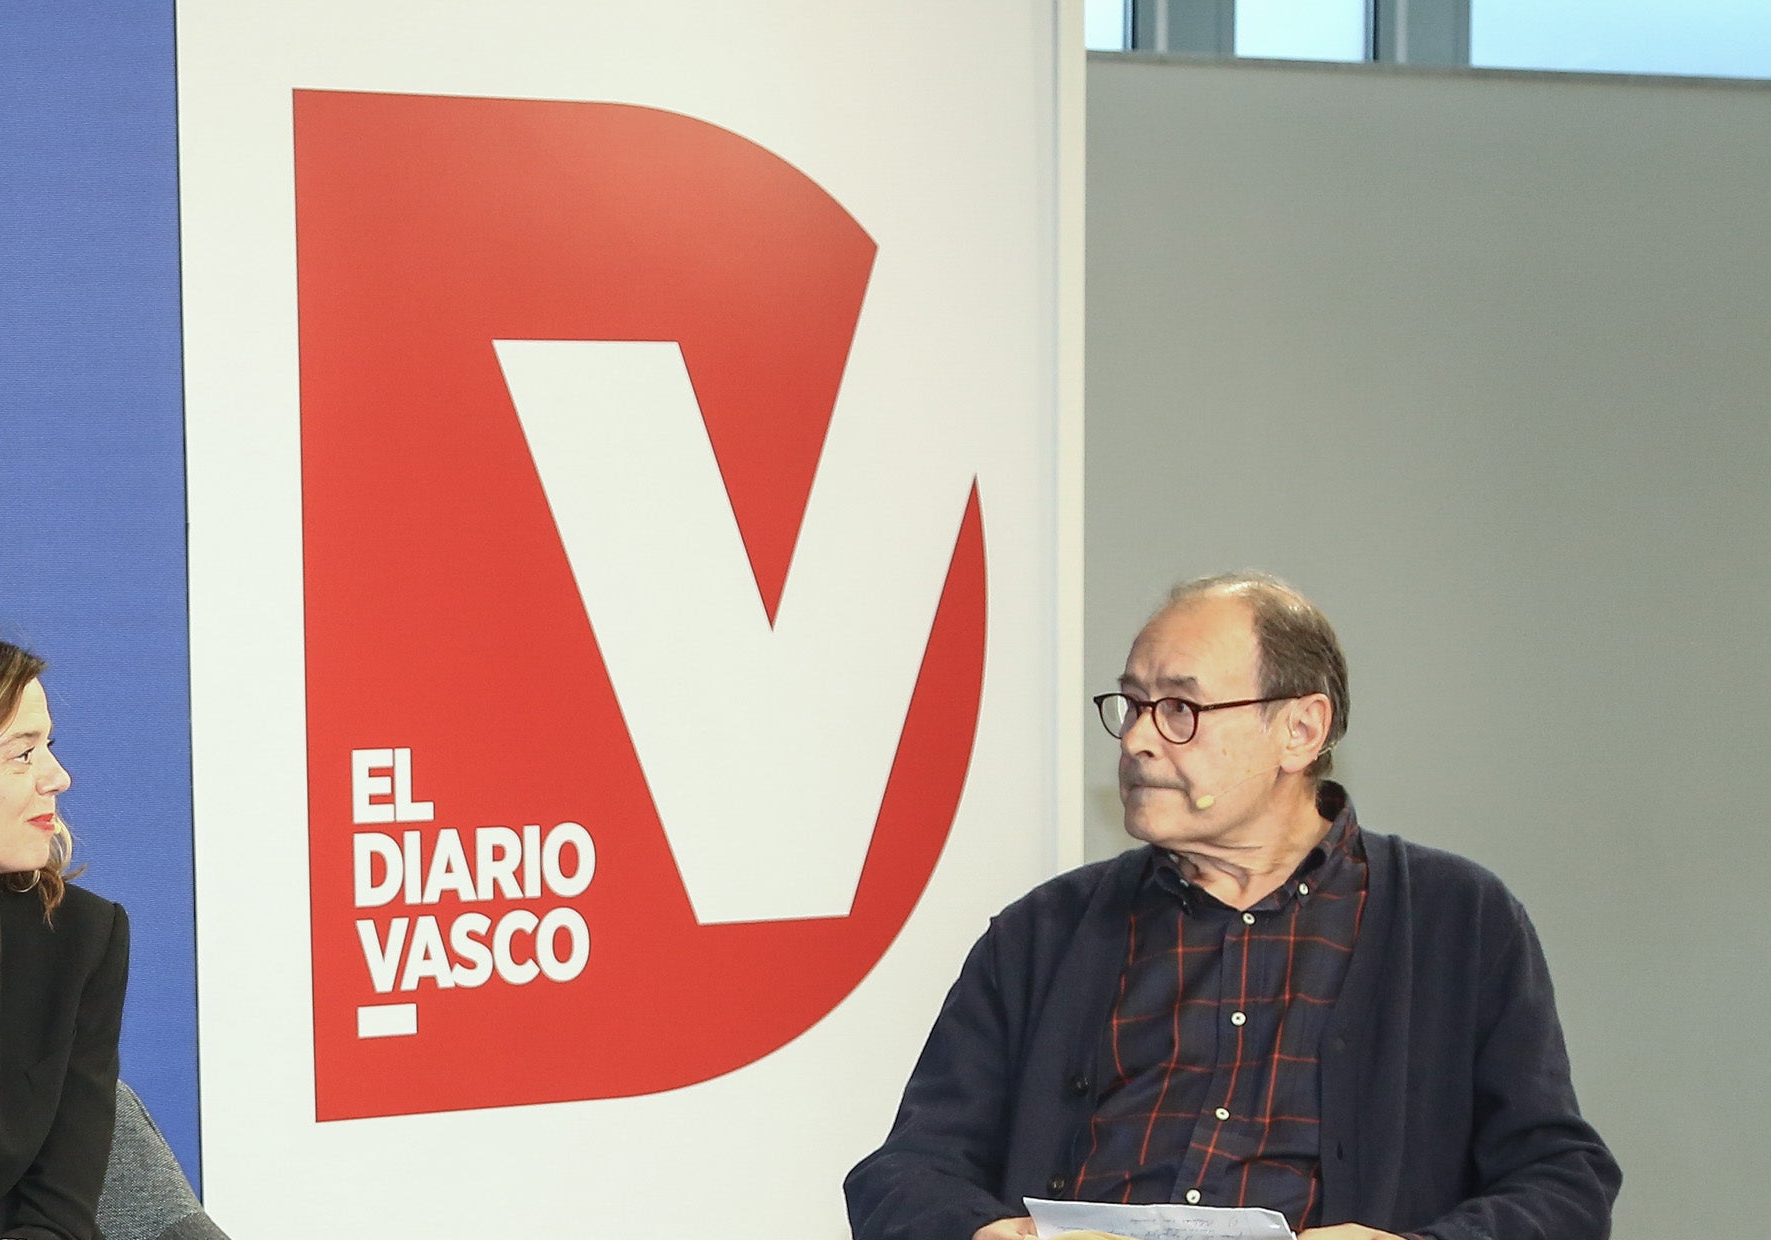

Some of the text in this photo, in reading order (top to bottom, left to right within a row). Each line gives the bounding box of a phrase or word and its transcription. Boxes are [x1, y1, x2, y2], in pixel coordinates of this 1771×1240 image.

[352, 747, 434, 824] EL
[353, 821, 597, 908] DIARIO
[355, 906, 591, 993] VASCO
